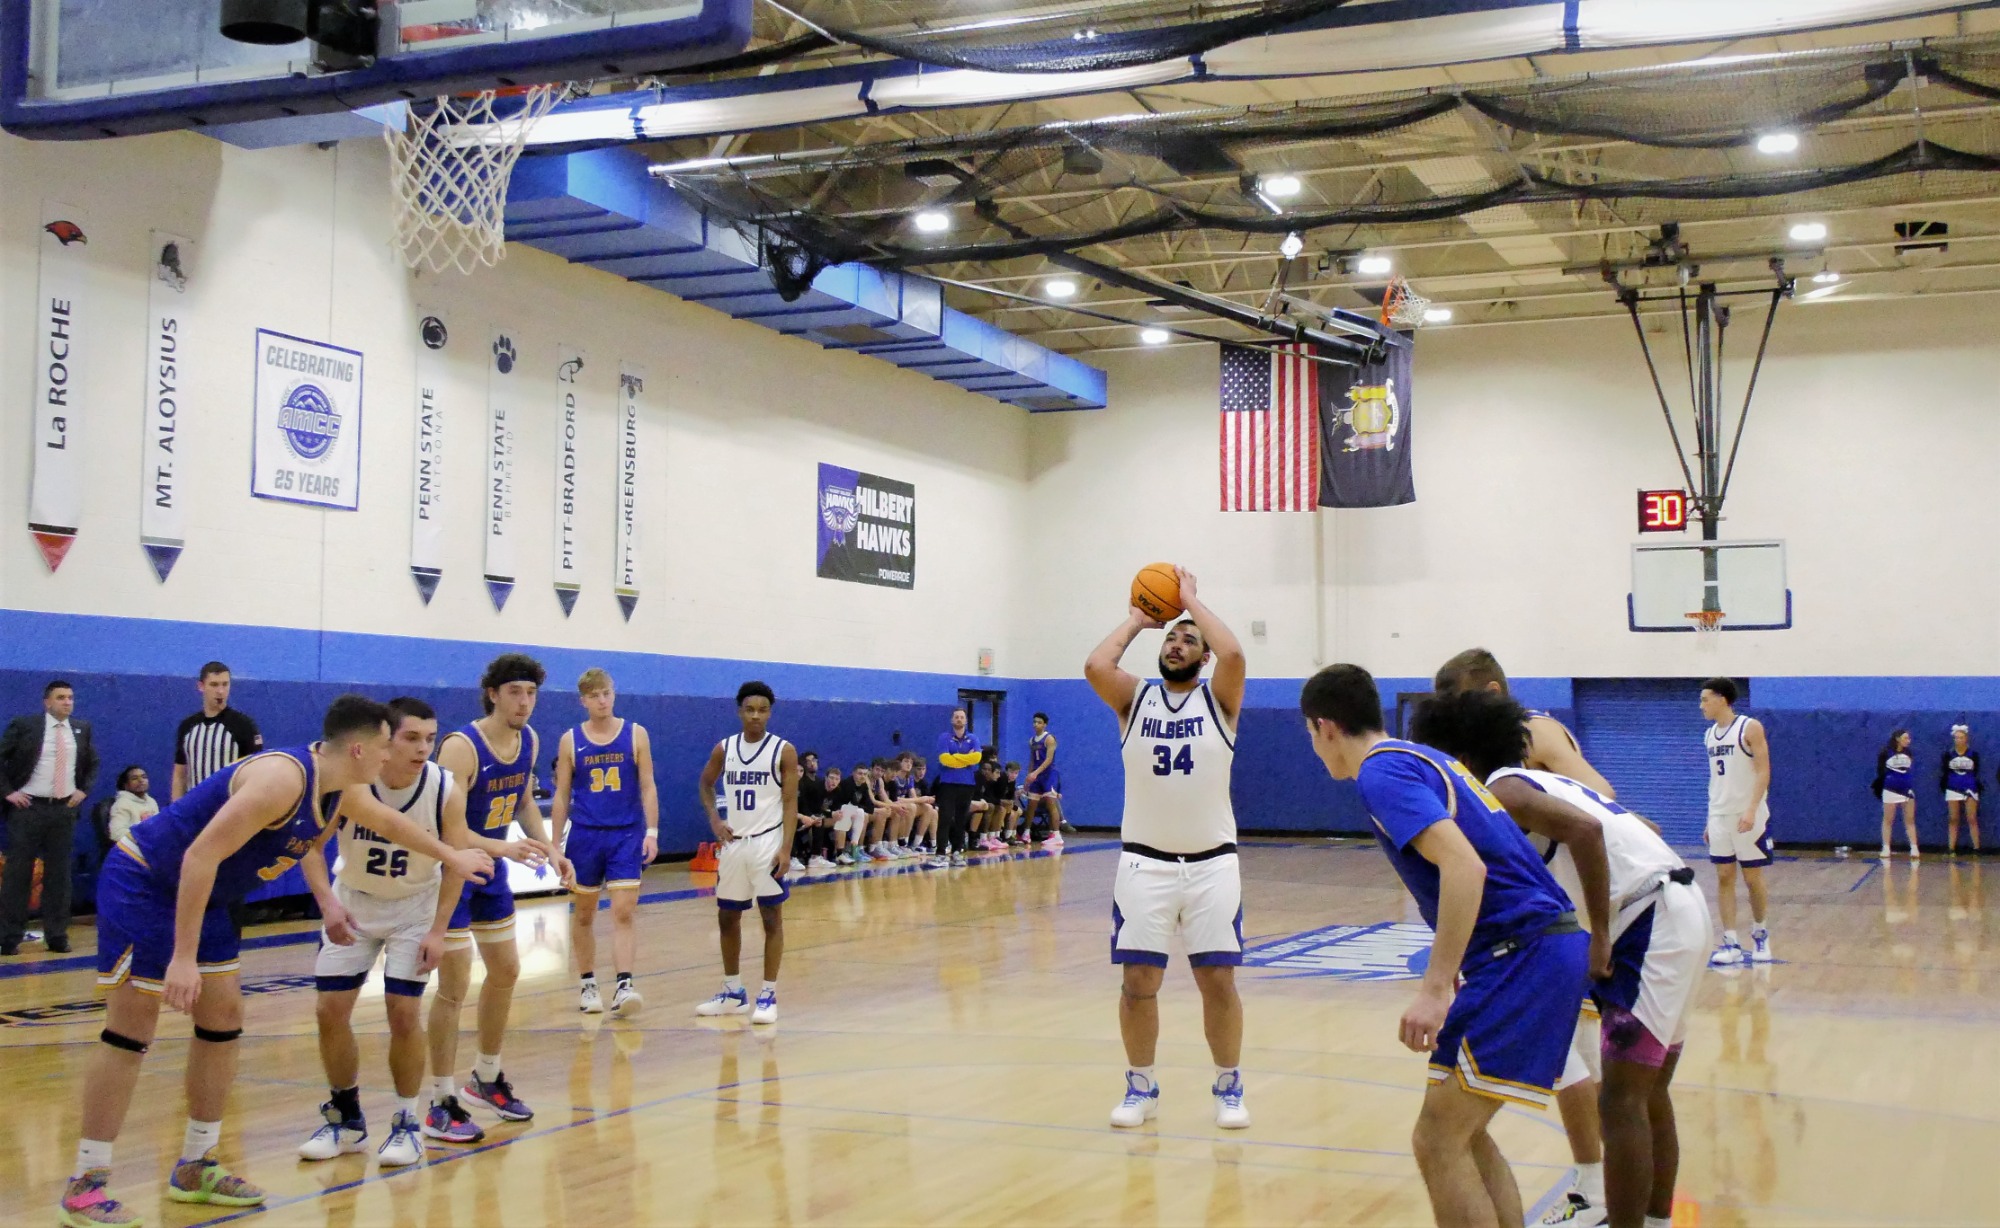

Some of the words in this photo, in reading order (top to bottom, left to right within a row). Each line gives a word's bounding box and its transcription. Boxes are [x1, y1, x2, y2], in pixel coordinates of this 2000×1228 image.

[48, 298, 71, 406] ROCHE
[266, 345, 354, 382] CELEBRATING
[158, 317, 177, 453] ALOYSIUS
[47, 415, 67, 450] La
[421, 387, 434, 453] STATE
[434, 410, 444, 502] ALTOONA
[493, 409, 506, 472] STATE
[156, 463, 173, 508] MT.
[274, 469, 294, 490] 25
[299, 472, 340, 497] YEARS
[418, 458, 431, 520] PENN
[562, 393, 576, 569] PITT-BRADFORD
[493, 477, 504, 536] PENN
[856, 486, 913, 523] HILBERT
[1646, 495, 1682, 525] 30
[857, 521, 911, 557] HAWKS
[1141, 716, 1204, 739] HILBERT
[584, 753, 624, 765] PANTHERS
[1152, 744, 1194, 776] 34
[1716, 759, 1726, 776] 3
[590, 766, 621, 792] 34
[484, 792, 518, 830] 22
[735, 789, 756, 811] 10
[366, 847, 409, 878] 25
